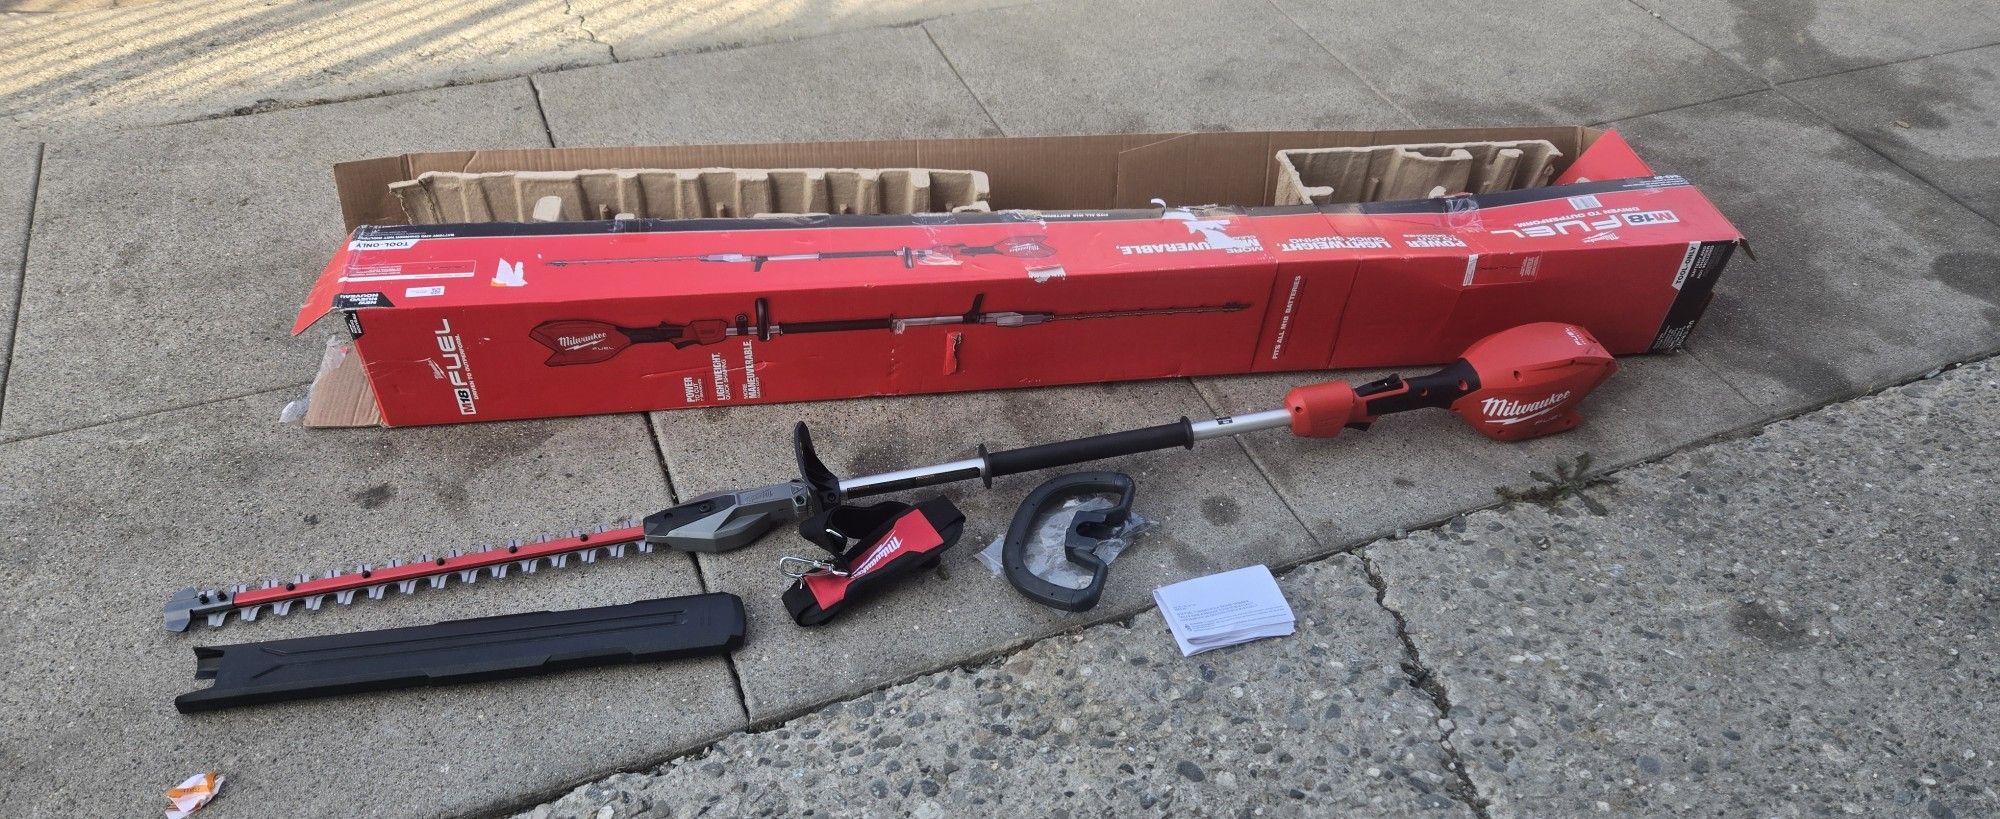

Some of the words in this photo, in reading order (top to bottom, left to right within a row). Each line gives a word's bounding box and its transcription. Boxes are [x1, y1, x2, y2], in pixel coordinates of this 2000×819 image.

[1603, 206, 1640, 215] DRIVEN
[1626, 211, 1677, 225] M18
[1491, 214, 1622, 238] FUEL
[1676, 246, 1697, 284] TOOL-ONLY
[558, 332, 607, 347] Milwaukee
[435, 319, 468, 386] FUEL
[466, 370, 474, 380] TO
[712, 352, 725, 400] LIGHTWEIGHT.
[743, 340, 756, 398] MANEUVERABLE.
[684, 377, 696, 402] POWER
[455, 390, 476, 414] M18
[1481, 391, 1570, 417] Milwaukee
